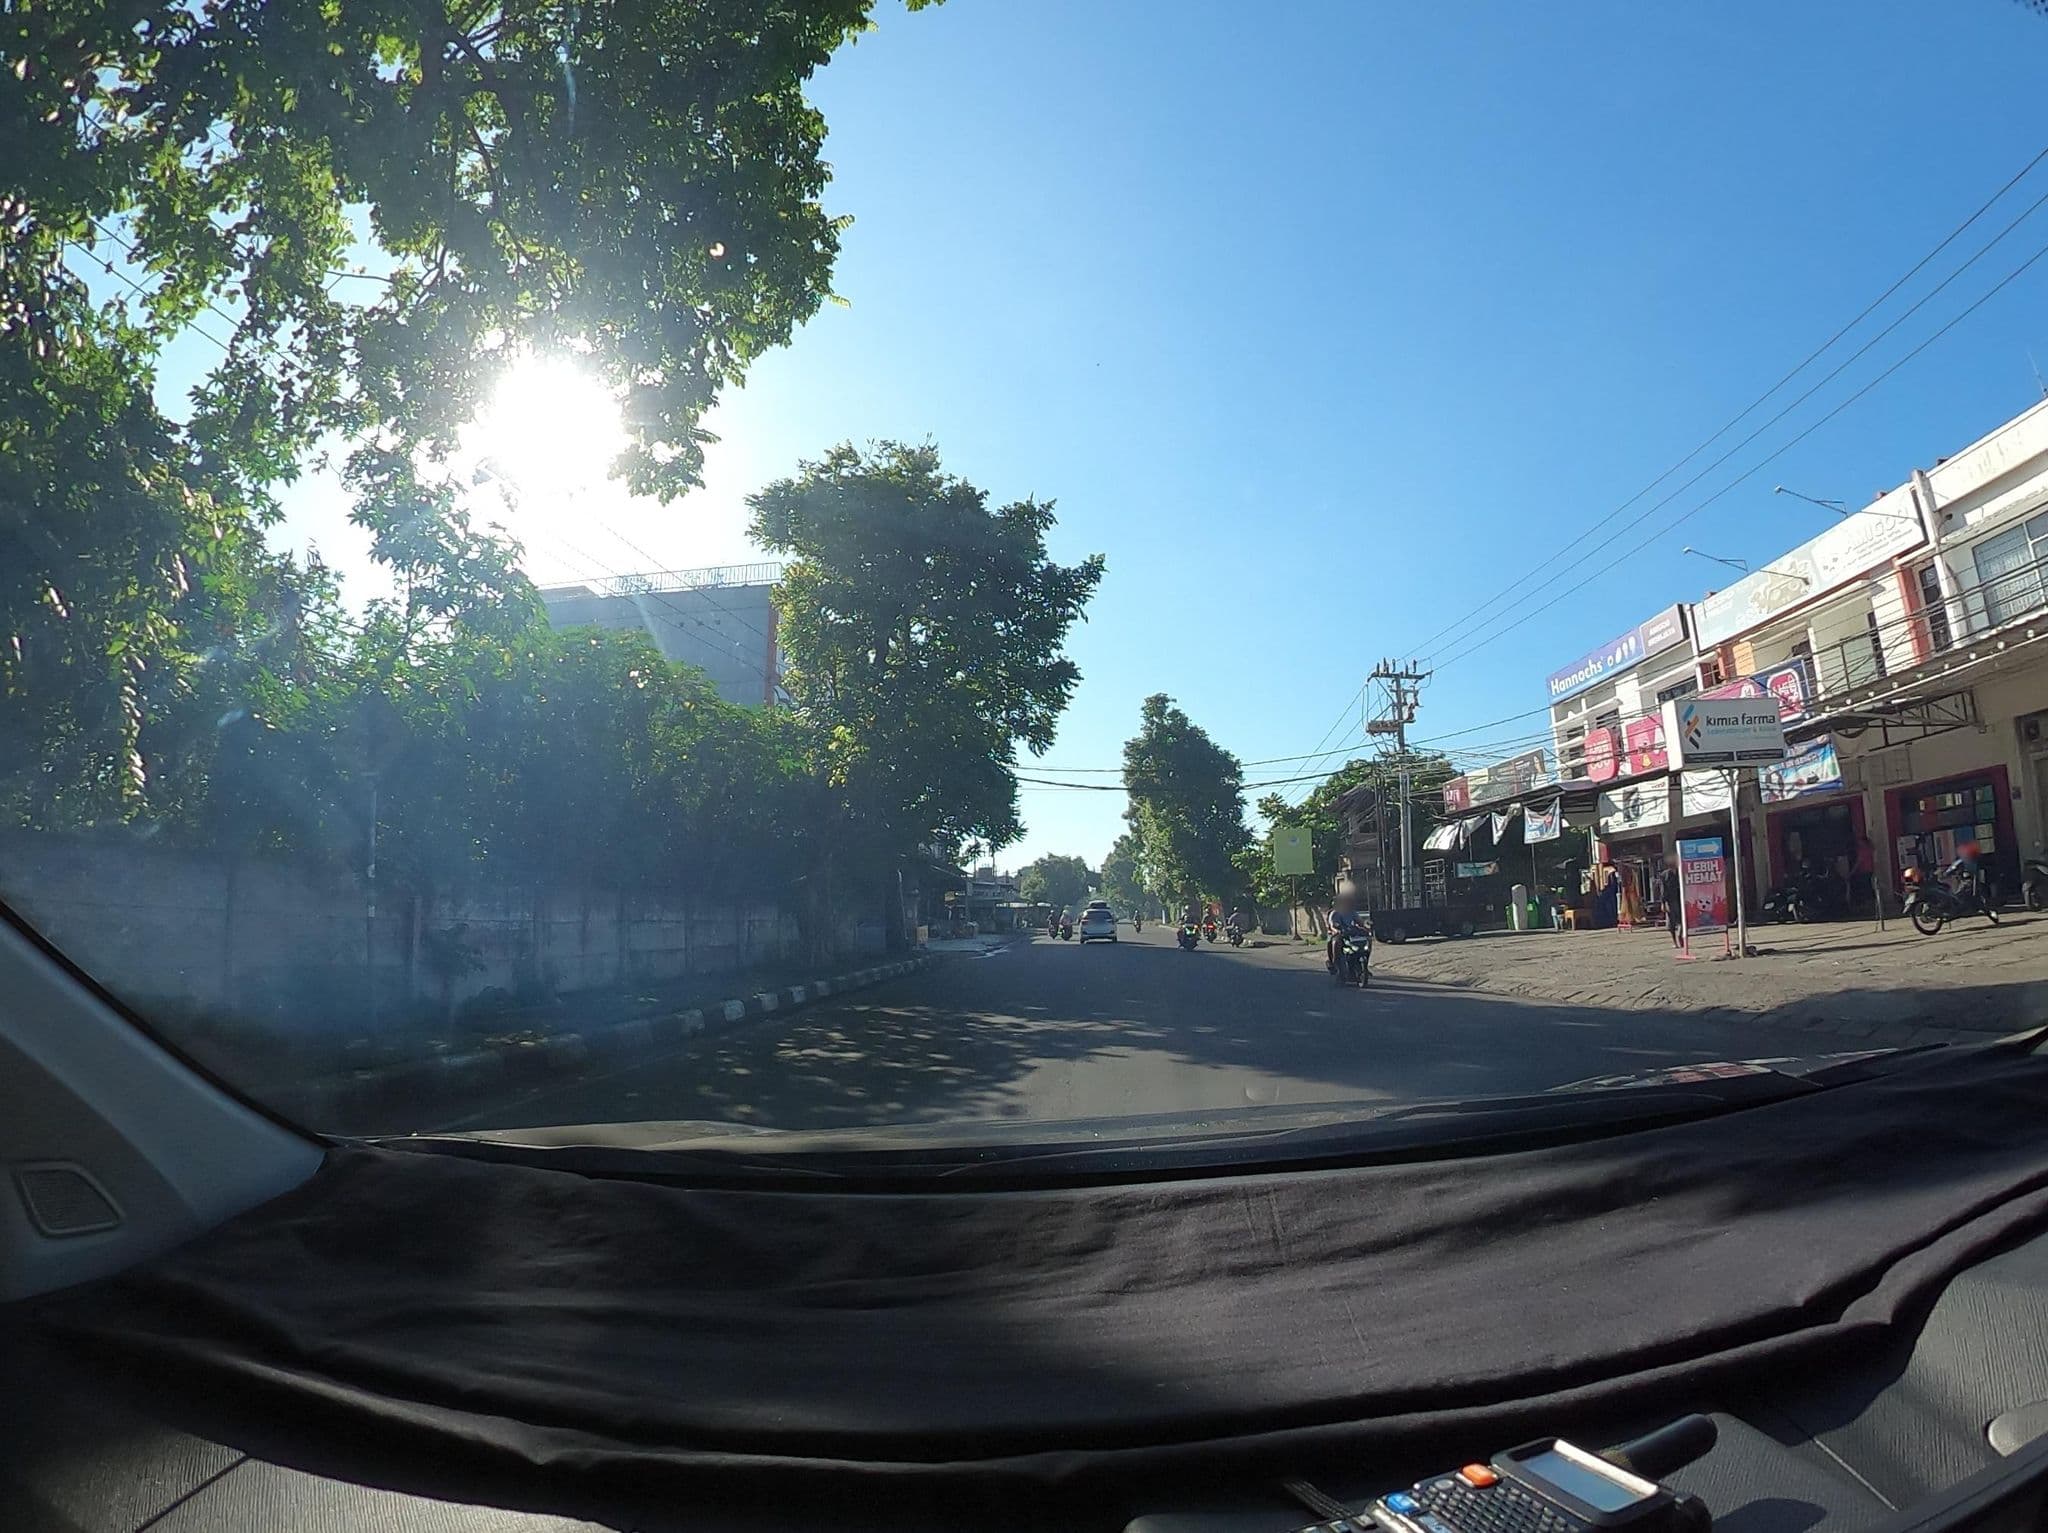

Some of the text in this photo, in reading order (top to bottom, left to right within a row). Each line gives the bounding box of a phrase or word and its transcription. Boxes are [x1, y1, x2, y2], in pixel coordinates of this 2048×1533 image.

[1706, 713, 1776, 726] kimia farma
[1687, 861, 1719, 873] LEBIH
[1686, 873, 1722, 884] HEMAT
